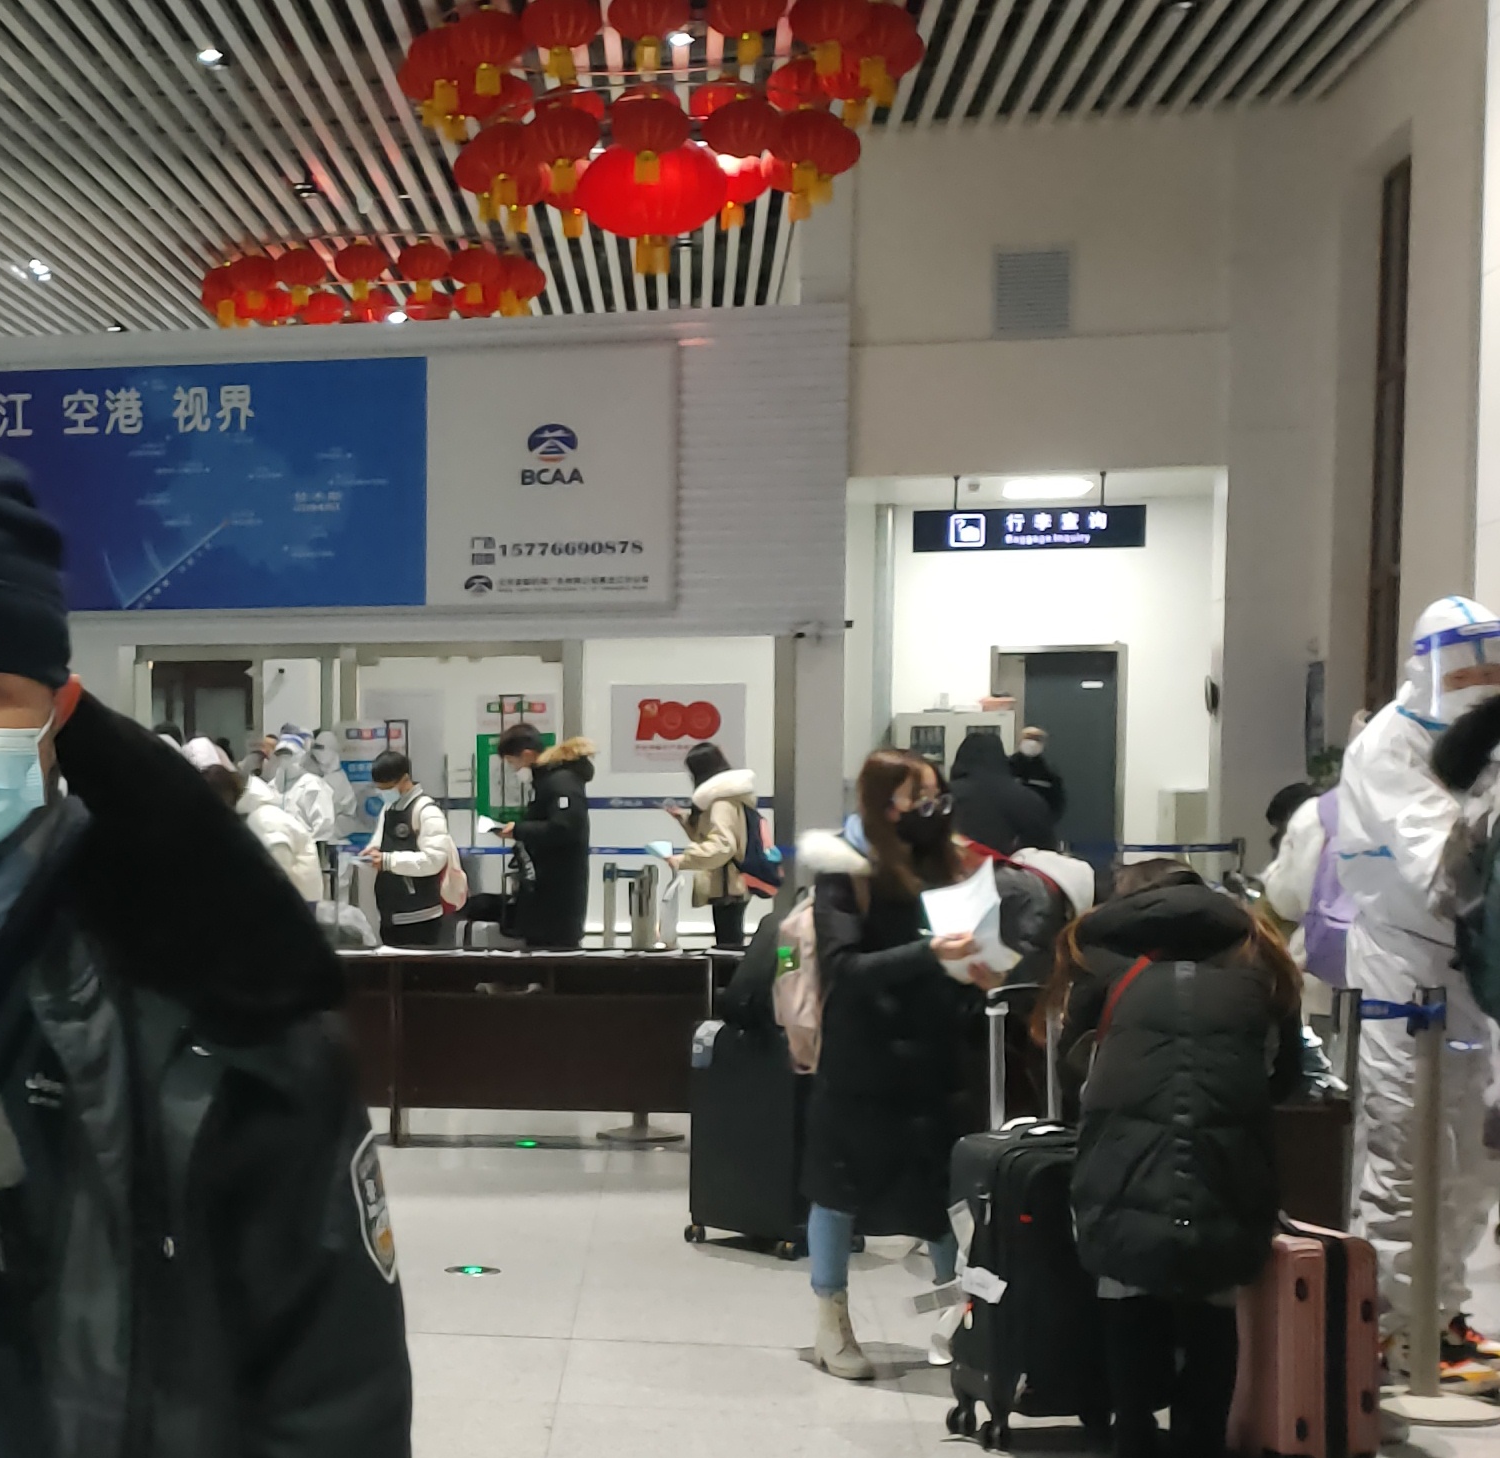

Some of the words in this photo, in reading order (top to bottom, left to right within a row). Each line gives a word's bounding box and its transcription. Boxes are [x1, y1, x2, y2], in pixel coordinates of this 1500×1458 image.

[62, 389, 143, 435] 空港
[173, 384, 255, 433] 视界
[521, 468, 584, 486] BCAA
[1005, 511, 1107, 532] 行李查询
[500, 540, 643, 557] 15776690878
